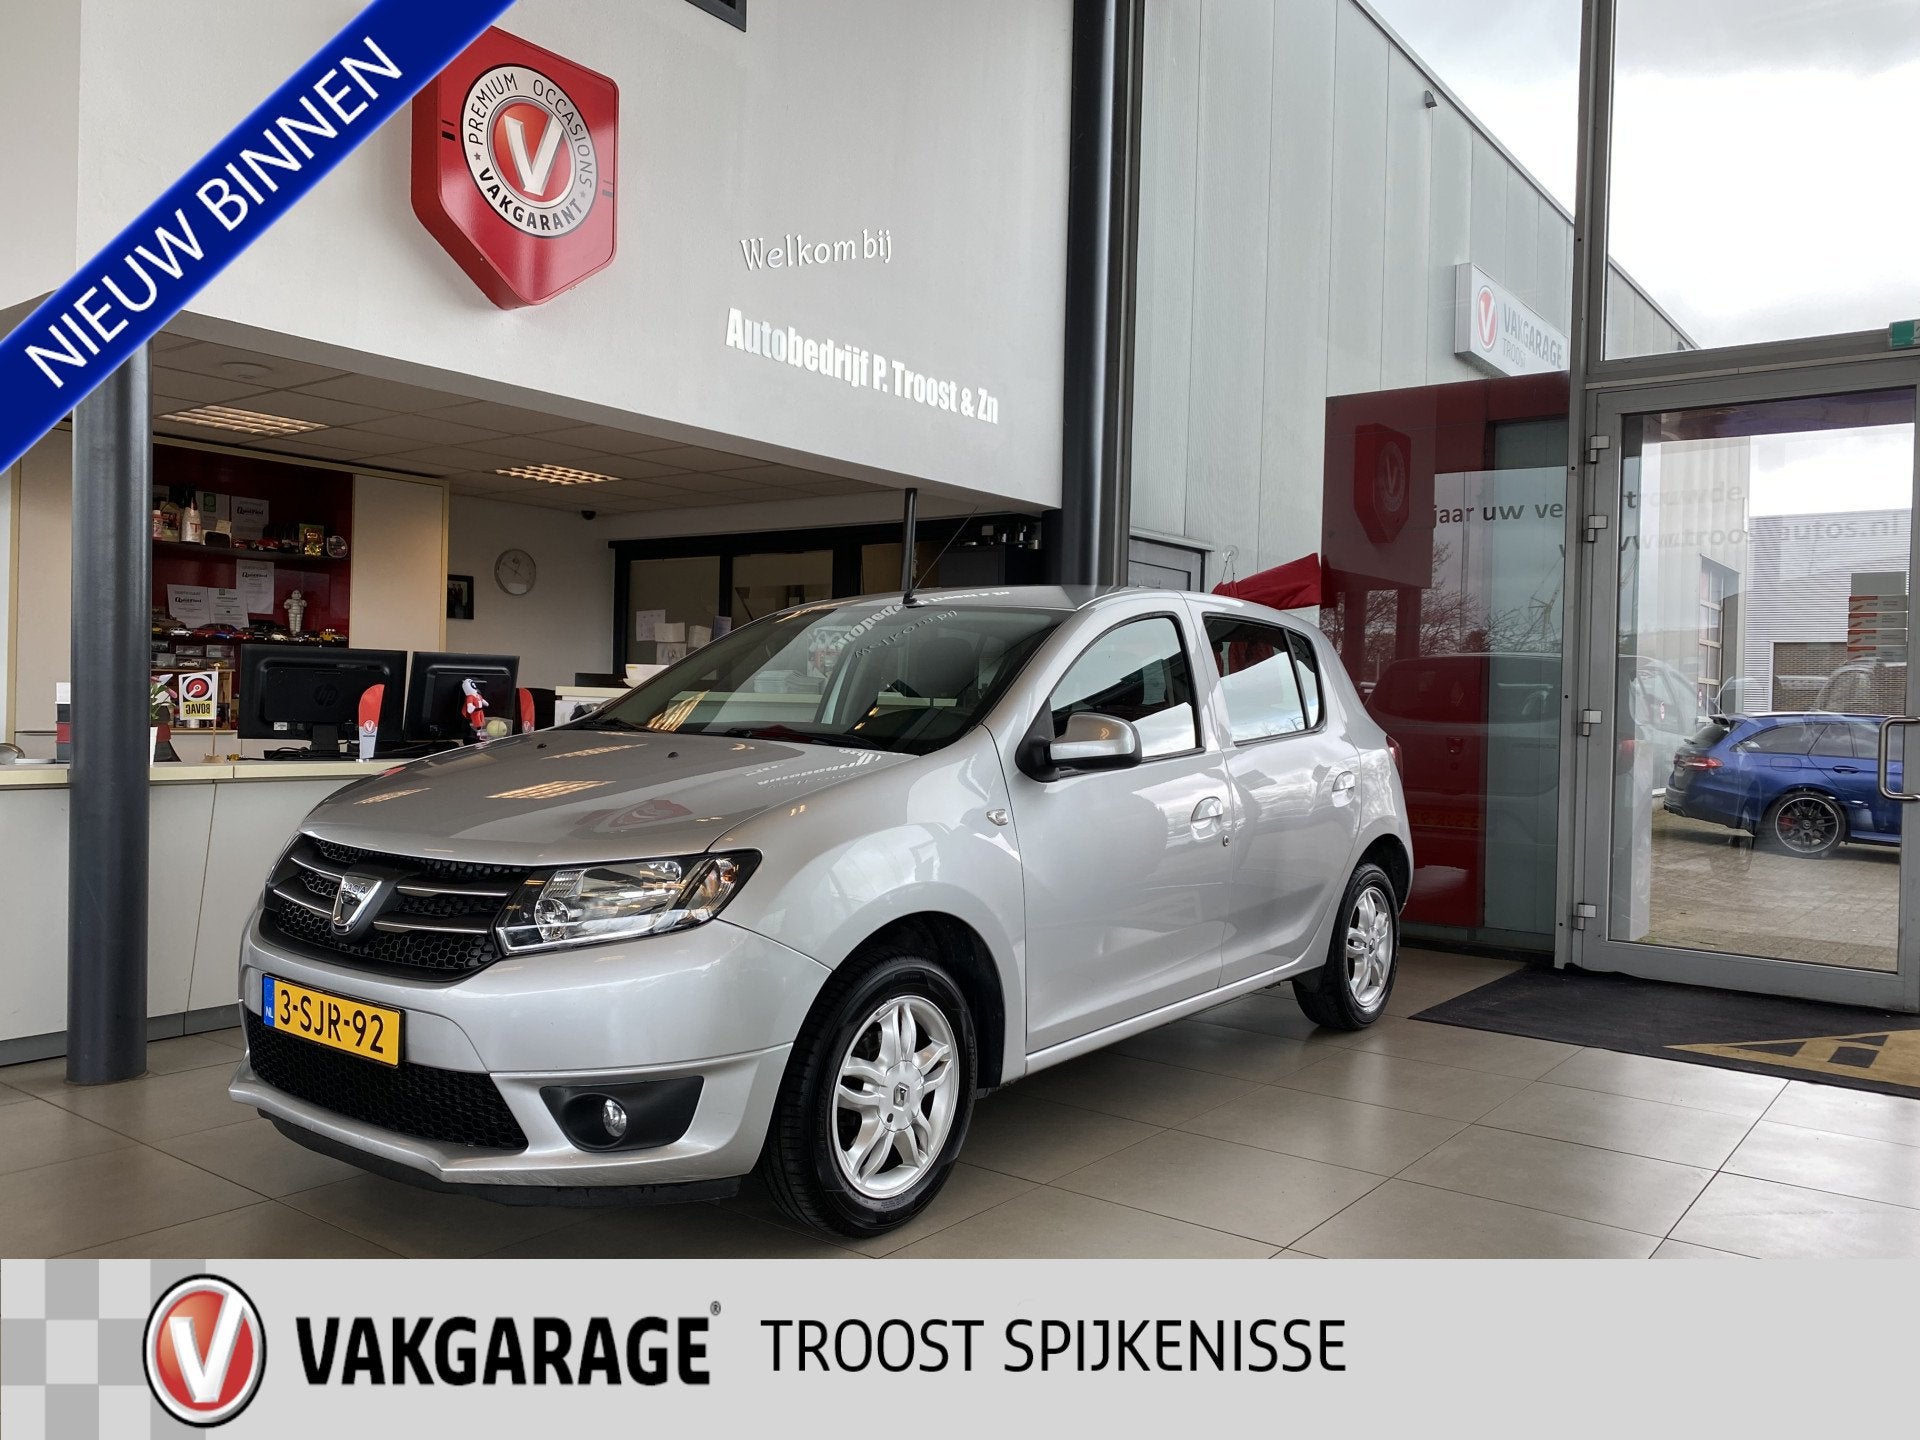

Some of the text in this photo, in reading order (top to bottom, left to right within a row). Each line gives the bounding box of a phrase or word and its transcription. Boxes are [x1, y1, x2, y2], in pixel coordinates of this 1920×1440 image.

[468, 72, 593, 189] PREMIUM OCCASIONS
[503, 114, 565, 197] V
[479, 167, 583, 231] VAKGARANT
[740, 228, 893, 271] Welkom bij
[725, 307, 998, 424] Autobedrijf P. Troost & Zn
[1503, 302, 1562, 370] VAKGARAGE
[1482, 504, 1525, 521] uw
[265, 989, 384, 1054] NL 3-SJR-92
